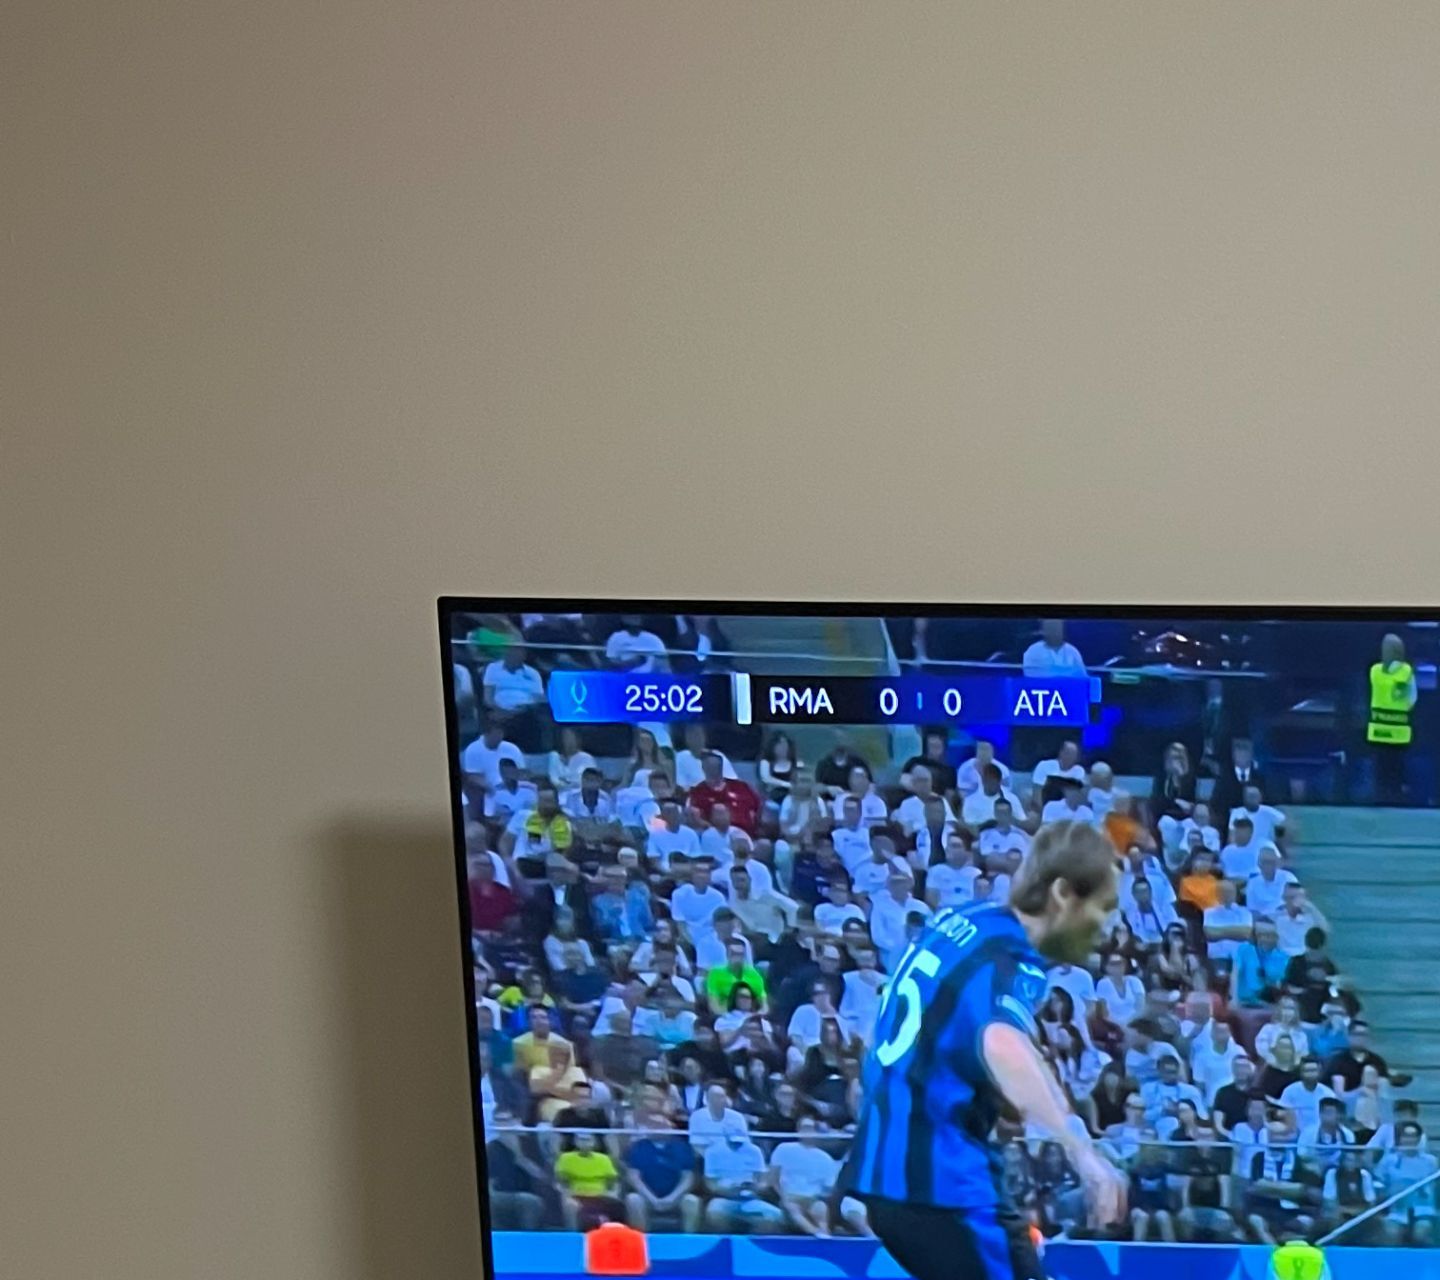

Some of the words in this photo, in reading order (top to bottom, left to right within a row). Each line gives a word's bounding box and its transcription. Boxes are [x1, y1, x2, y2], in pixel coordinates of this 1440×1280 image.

[624, 685, 703, 713] 25:02
[769, 686, 835, 715] RMA
[879, 687, 899, 716] 0
[942, 688, 963, 717] 0
[1012, 689, 1069, 718] ATA
